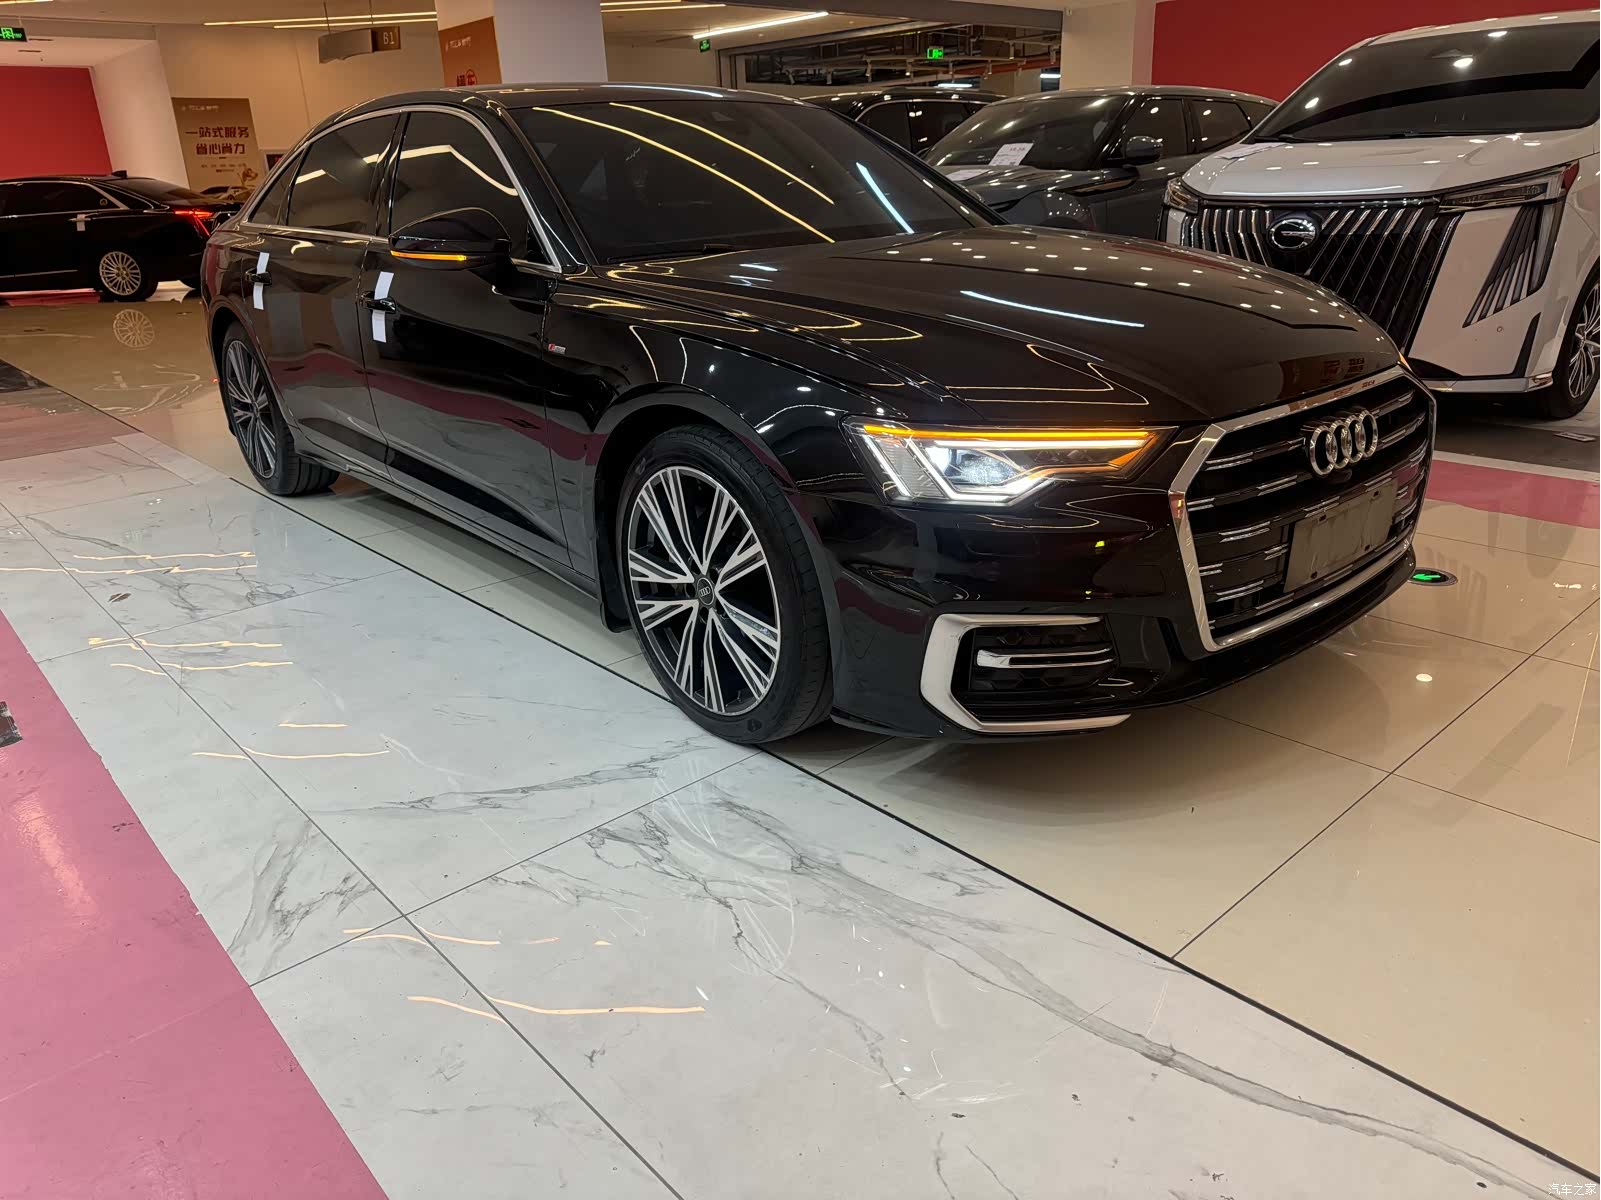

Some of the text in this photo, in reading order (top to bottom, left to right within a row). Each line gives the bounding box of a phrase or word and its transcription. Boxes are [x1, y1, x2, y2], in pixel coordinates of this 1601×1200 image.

[383, 31, 395, 45] B1
[185, 126, 249, 138] 一站式服务
[196, 143, 245, 155] 省心省力
